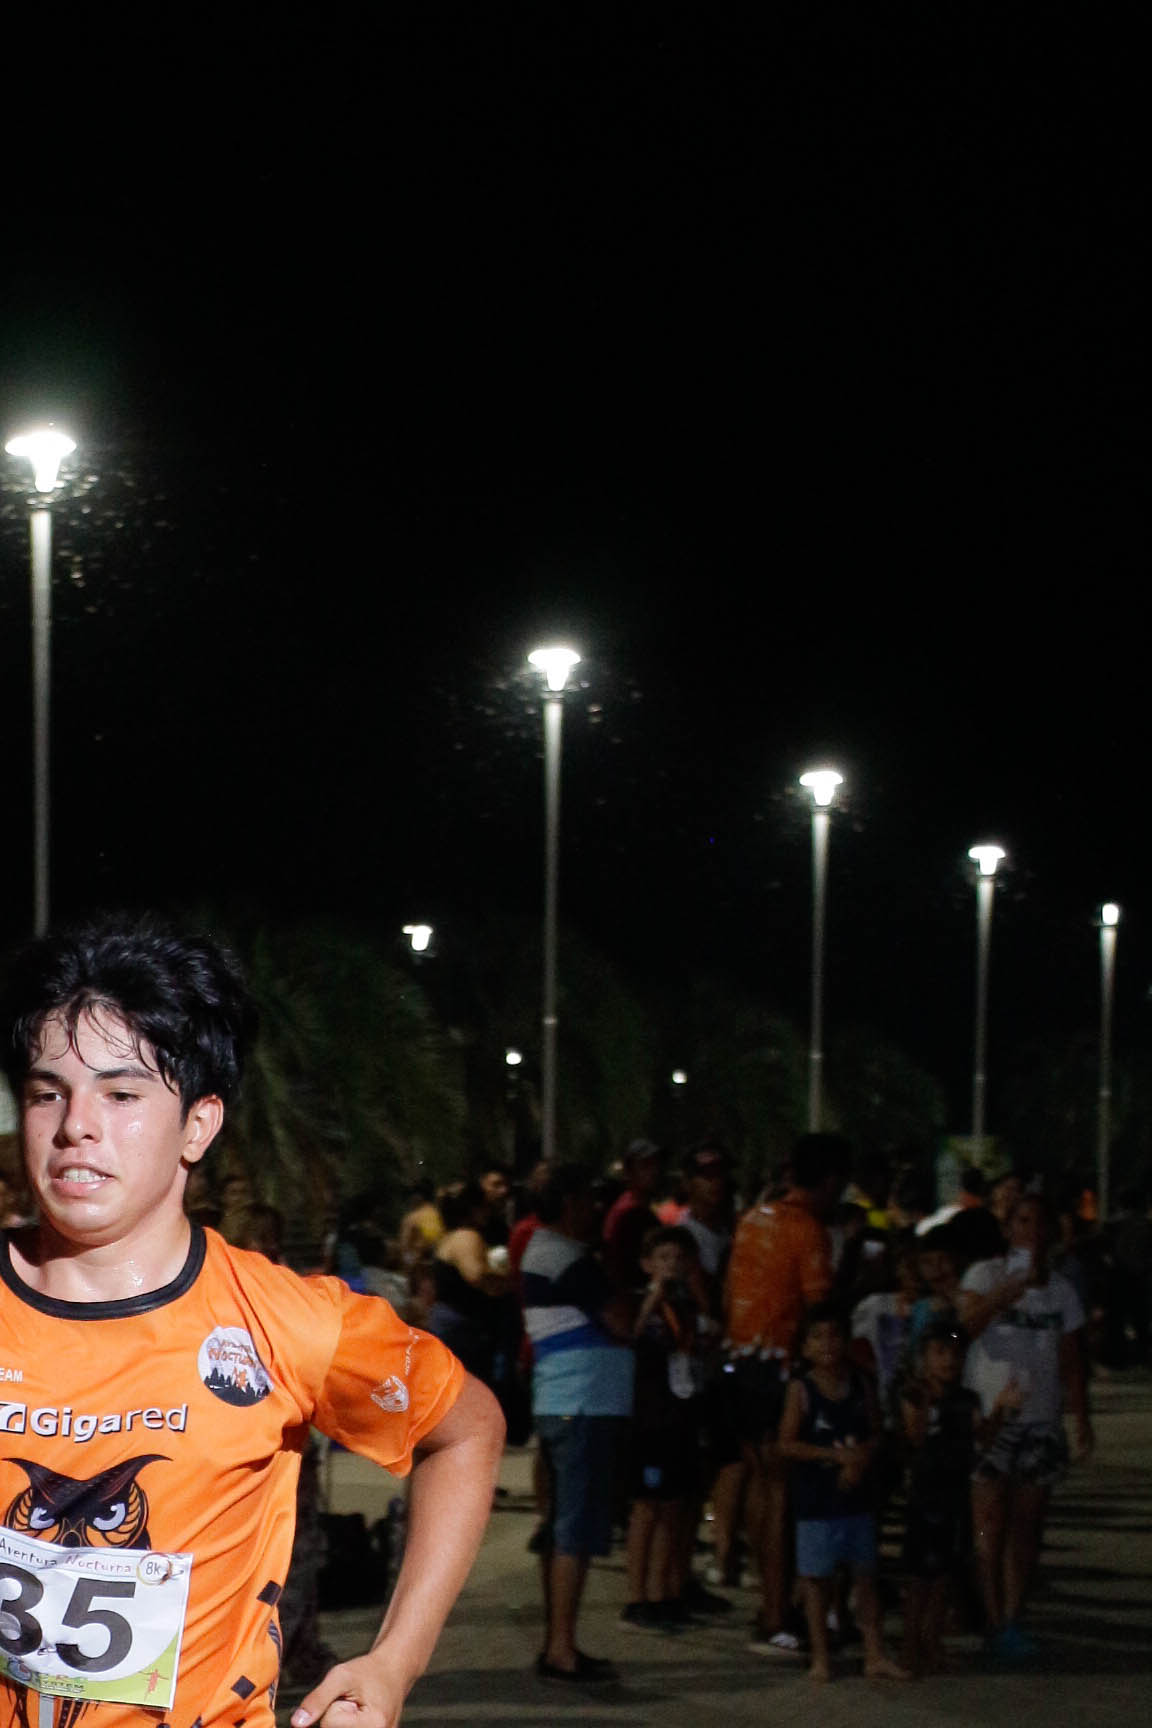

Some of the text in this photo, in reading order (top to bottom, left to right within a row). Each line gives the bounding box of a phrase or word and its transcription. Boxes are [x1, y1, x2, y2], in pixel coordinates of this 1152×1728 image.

[30, 1403, 188, 1443] Gigared
[64, 1554, 132, 1574] Nocturna
[145, 1560, 160, 1575] 8k
